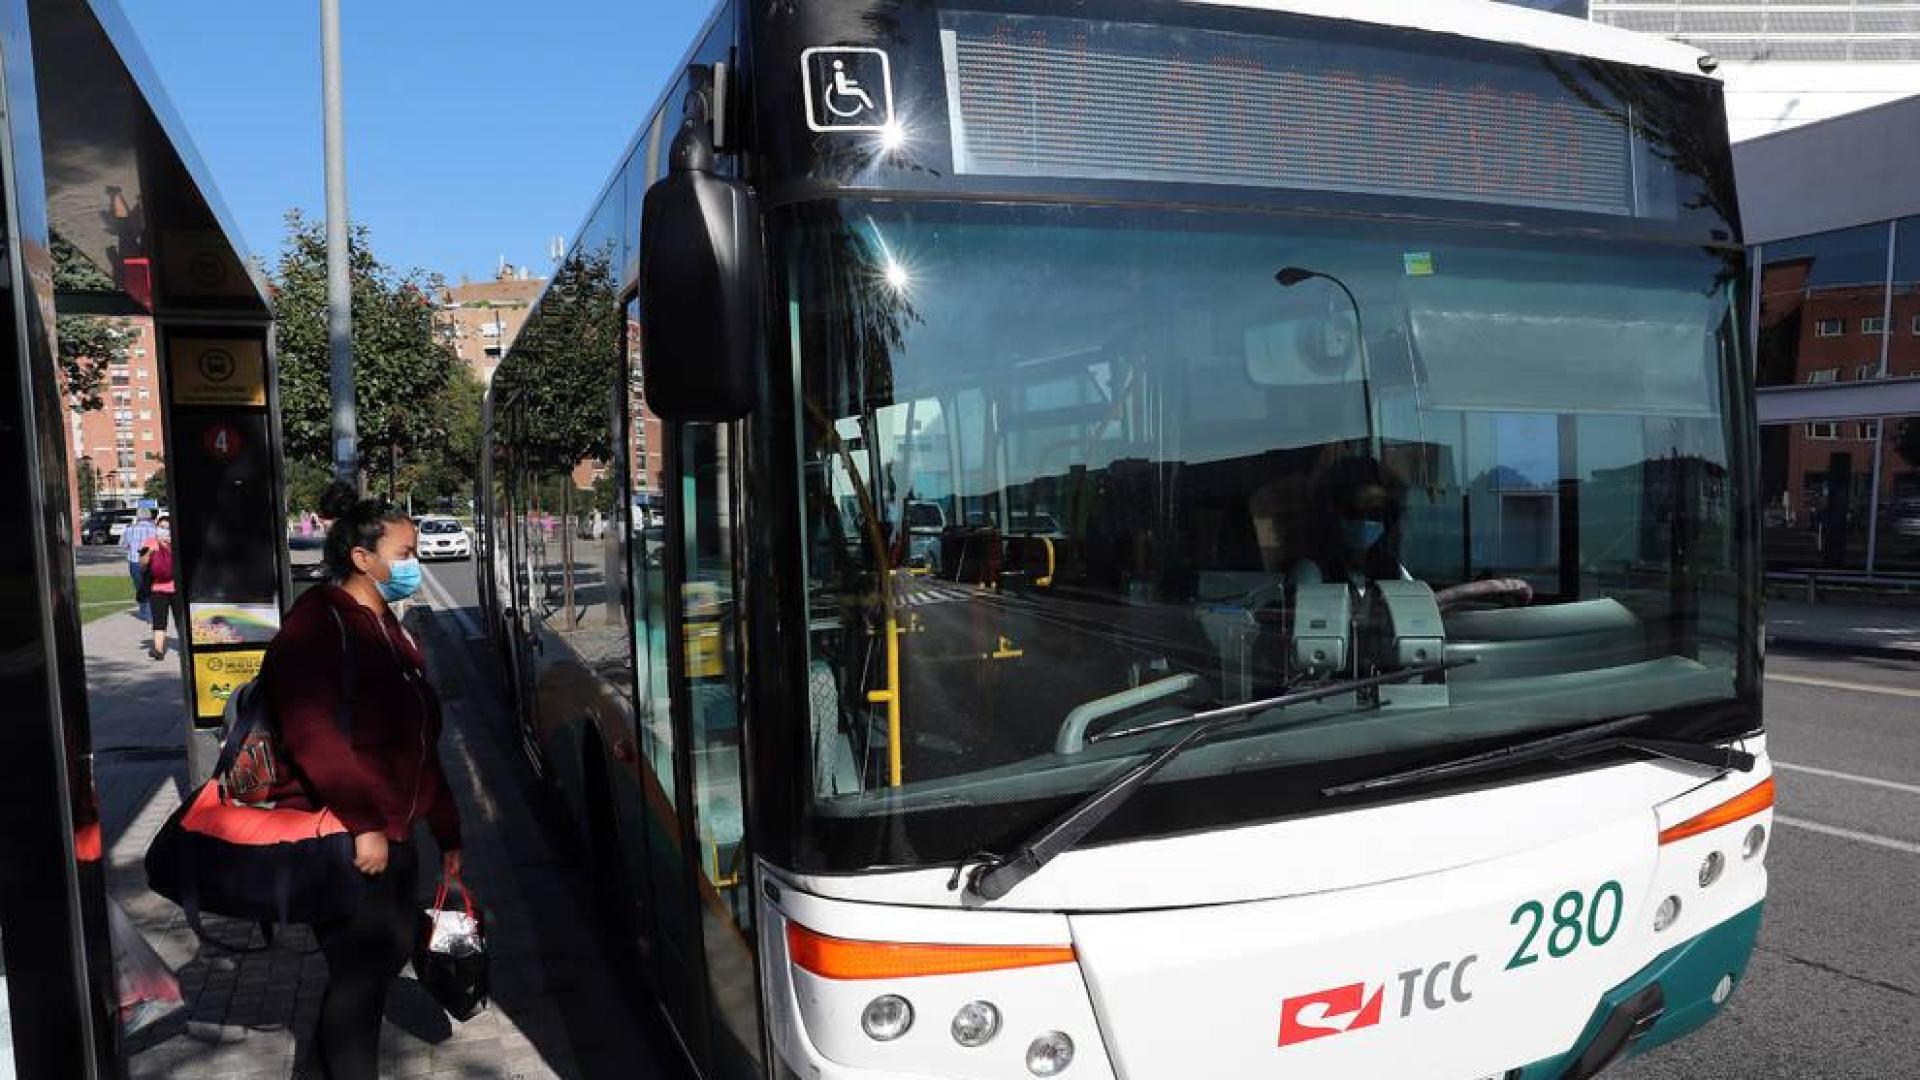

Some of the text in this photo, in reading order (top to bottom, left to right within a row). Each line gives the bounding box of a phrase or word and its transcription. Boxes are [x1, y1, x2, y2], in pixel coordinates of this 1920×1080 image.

[214, 430, 228, 453] 4
[1504, 880, 1624, 970] 280
[1397, 954, 1479, 1018] TCC
